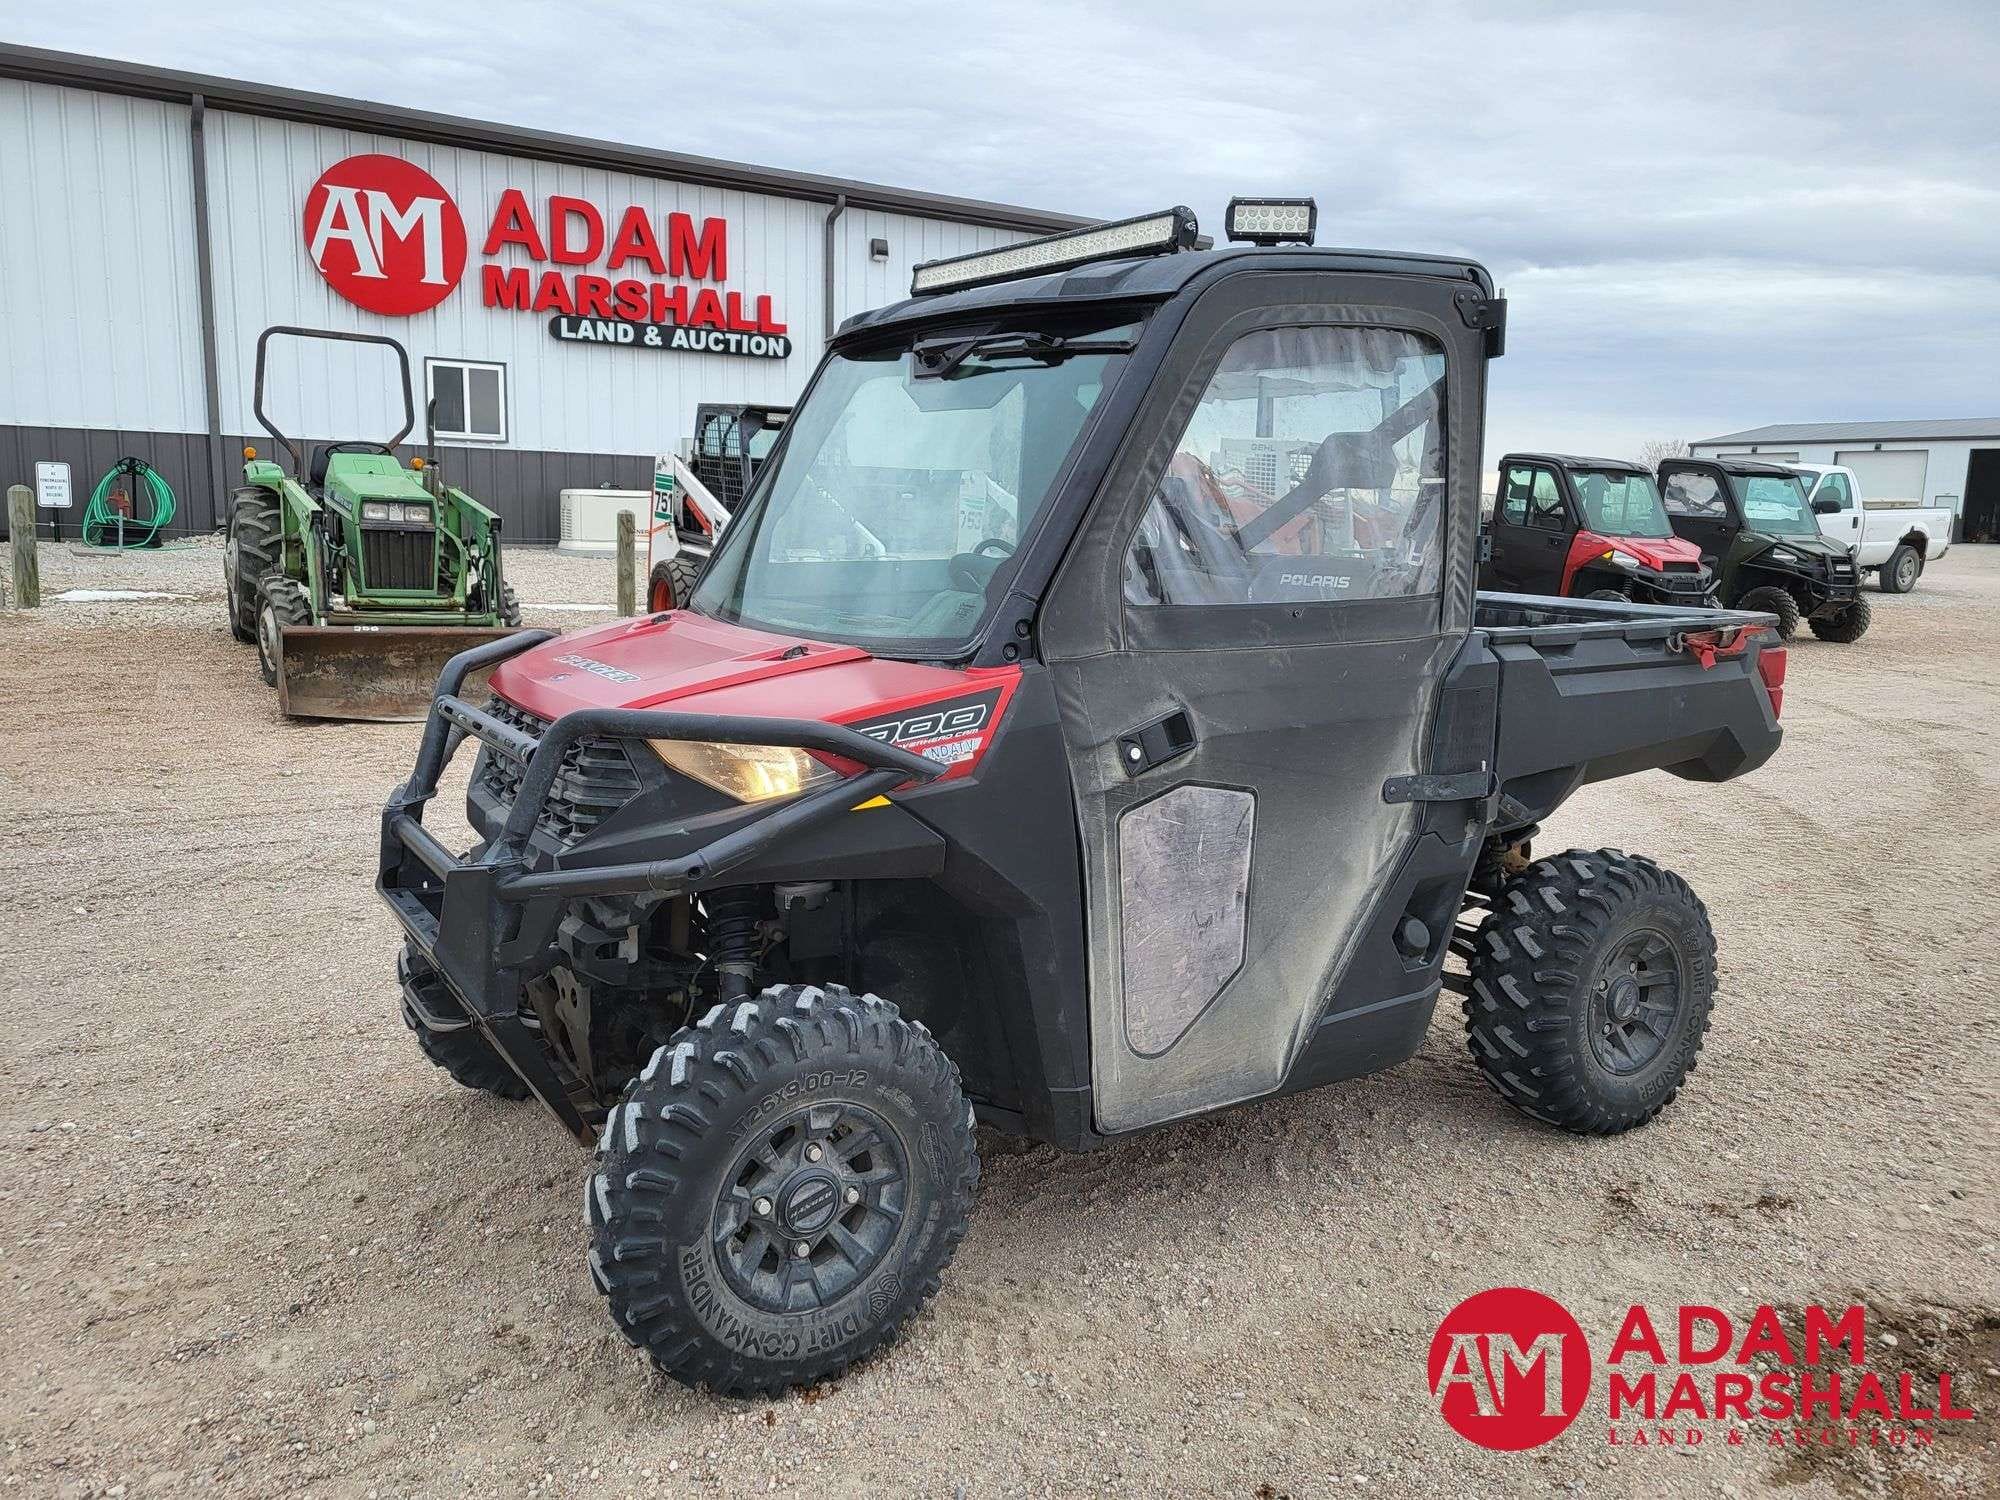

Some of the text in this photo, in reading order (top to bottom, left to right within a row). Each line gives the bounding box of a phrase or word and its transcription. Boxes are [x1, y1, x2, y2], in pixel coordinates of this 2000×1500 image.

[308, 183, 450, 286] AM
[482, 188, 727, 282] ADAM
[482, 264, 787, 334] MARSHALL
[560, 317, 785, 357] LAND & AUCTION
[655, 491, 673, 514] 751
[1280, 573, 1351, 589] POLARIS
[682, 1246, 801, 1358] COMMANDER
[807, 1312, 862, 1355] DIRT
